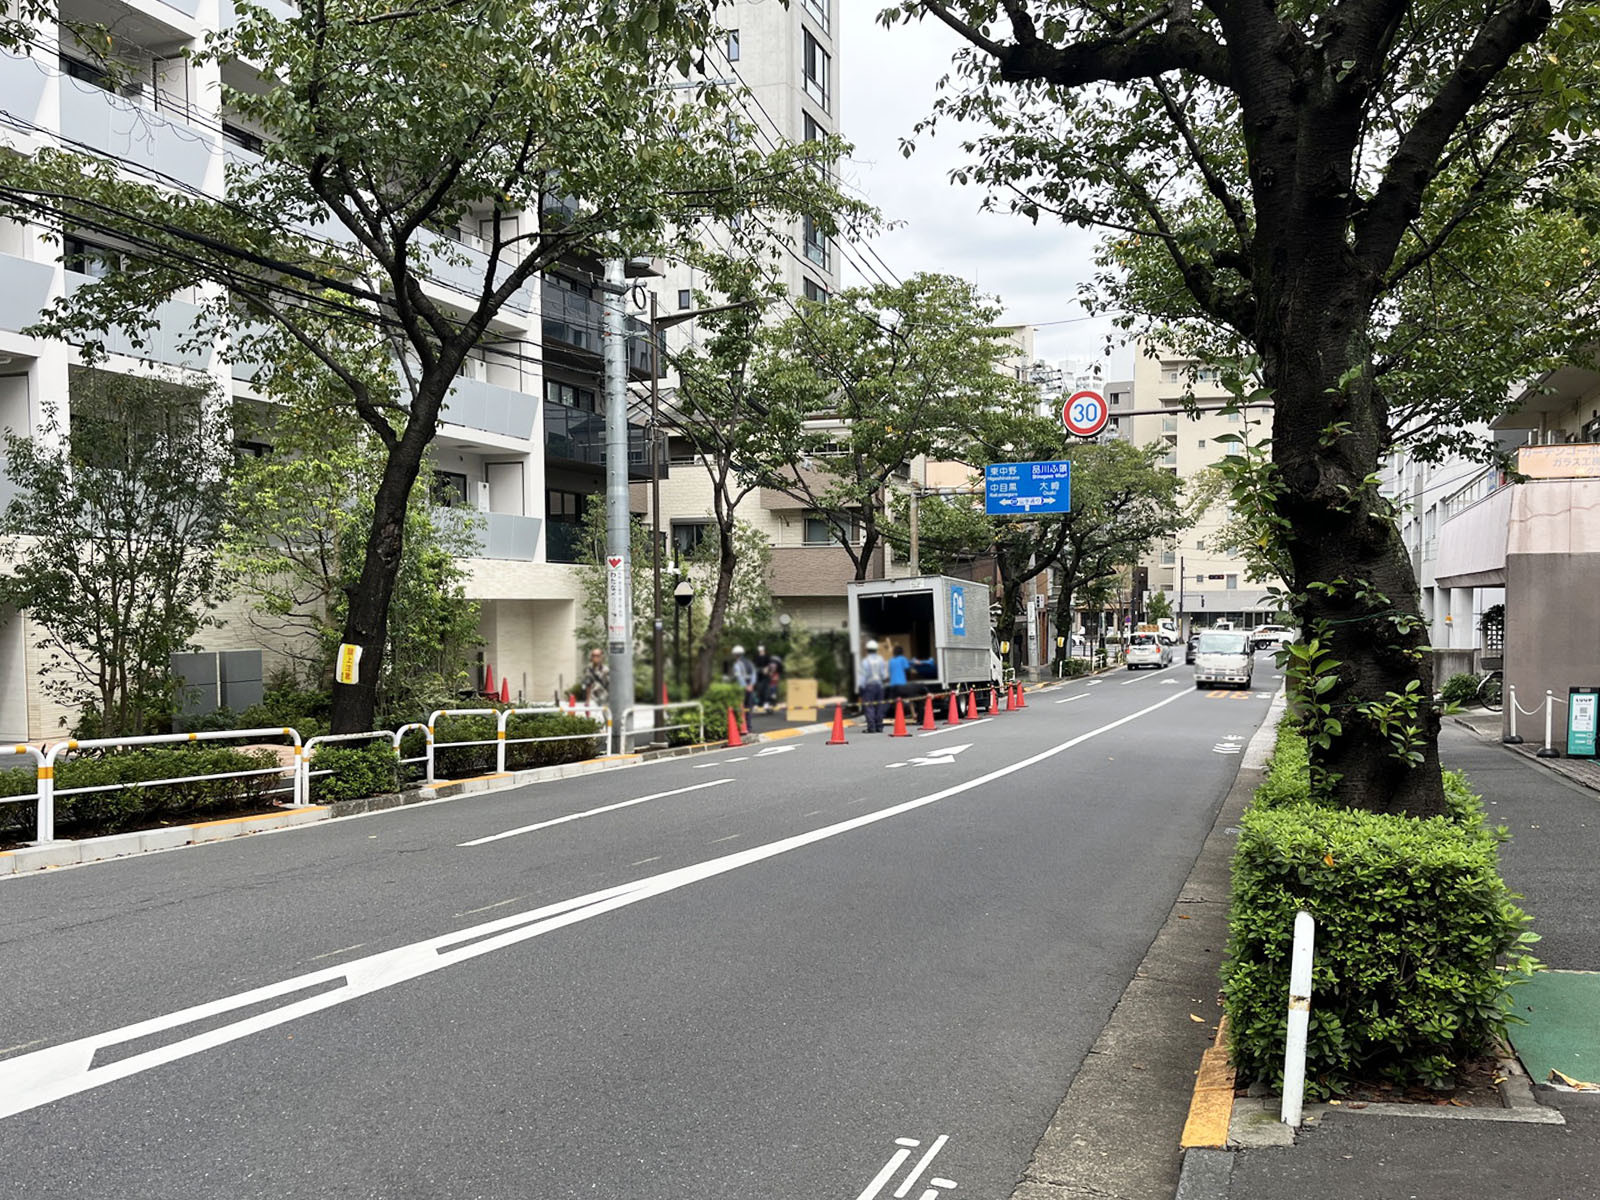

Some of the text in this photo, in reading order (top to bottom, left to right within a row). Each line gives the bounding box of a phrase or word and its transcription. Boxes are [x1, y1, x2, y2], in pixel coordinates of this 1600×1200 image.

[1073, 403, 1097, 422] 30
[990, 466, 1017, 476] 東中野
[1032, 464, 1068, 474] 品川ふ頭
[990, 482, 1018, 492] 中目黒
[1040, 481, 1060, 491] 大崎
